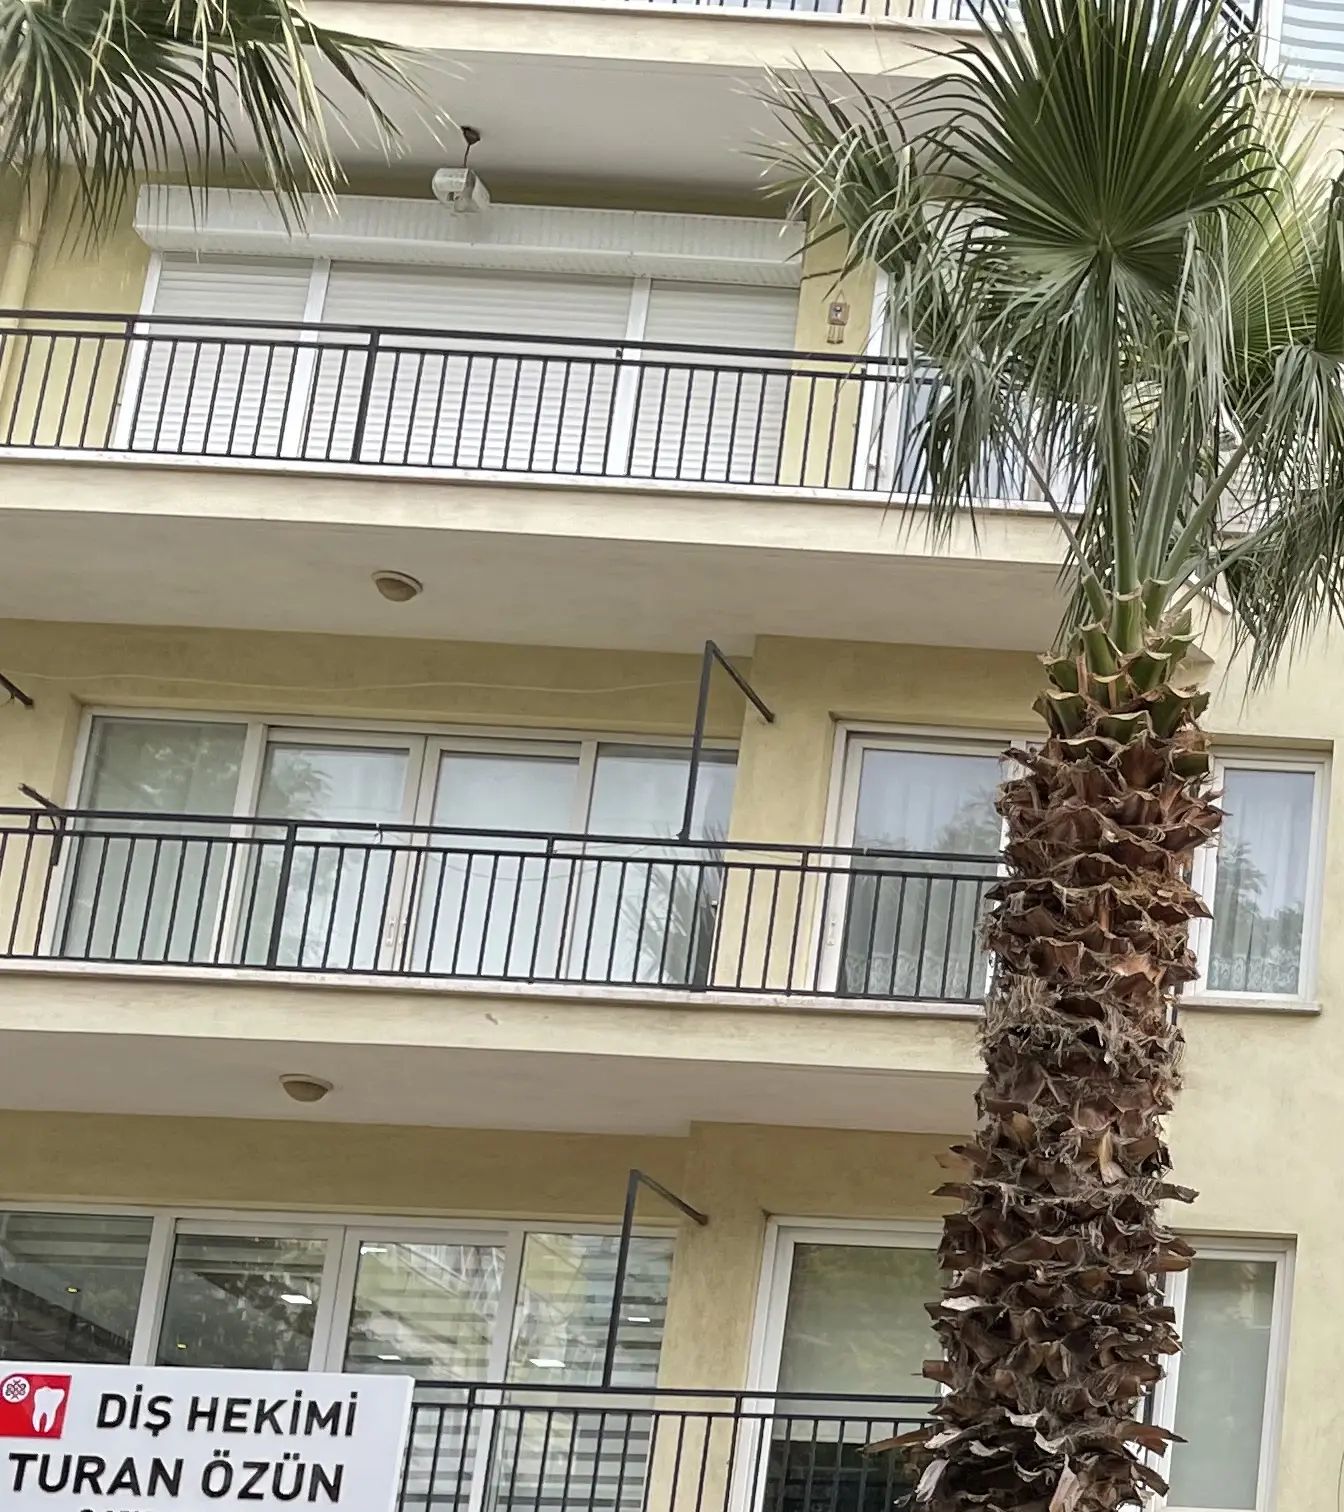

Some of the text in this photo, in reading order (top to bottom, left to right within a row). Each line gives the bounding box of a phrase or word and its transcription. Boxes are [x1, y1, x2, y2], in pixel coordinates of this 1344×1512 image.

[97, 1384, 358, 1438] DİŞ HEKİMİ
[9, 1450, 344, 1503] TURAN ÖZÜN
